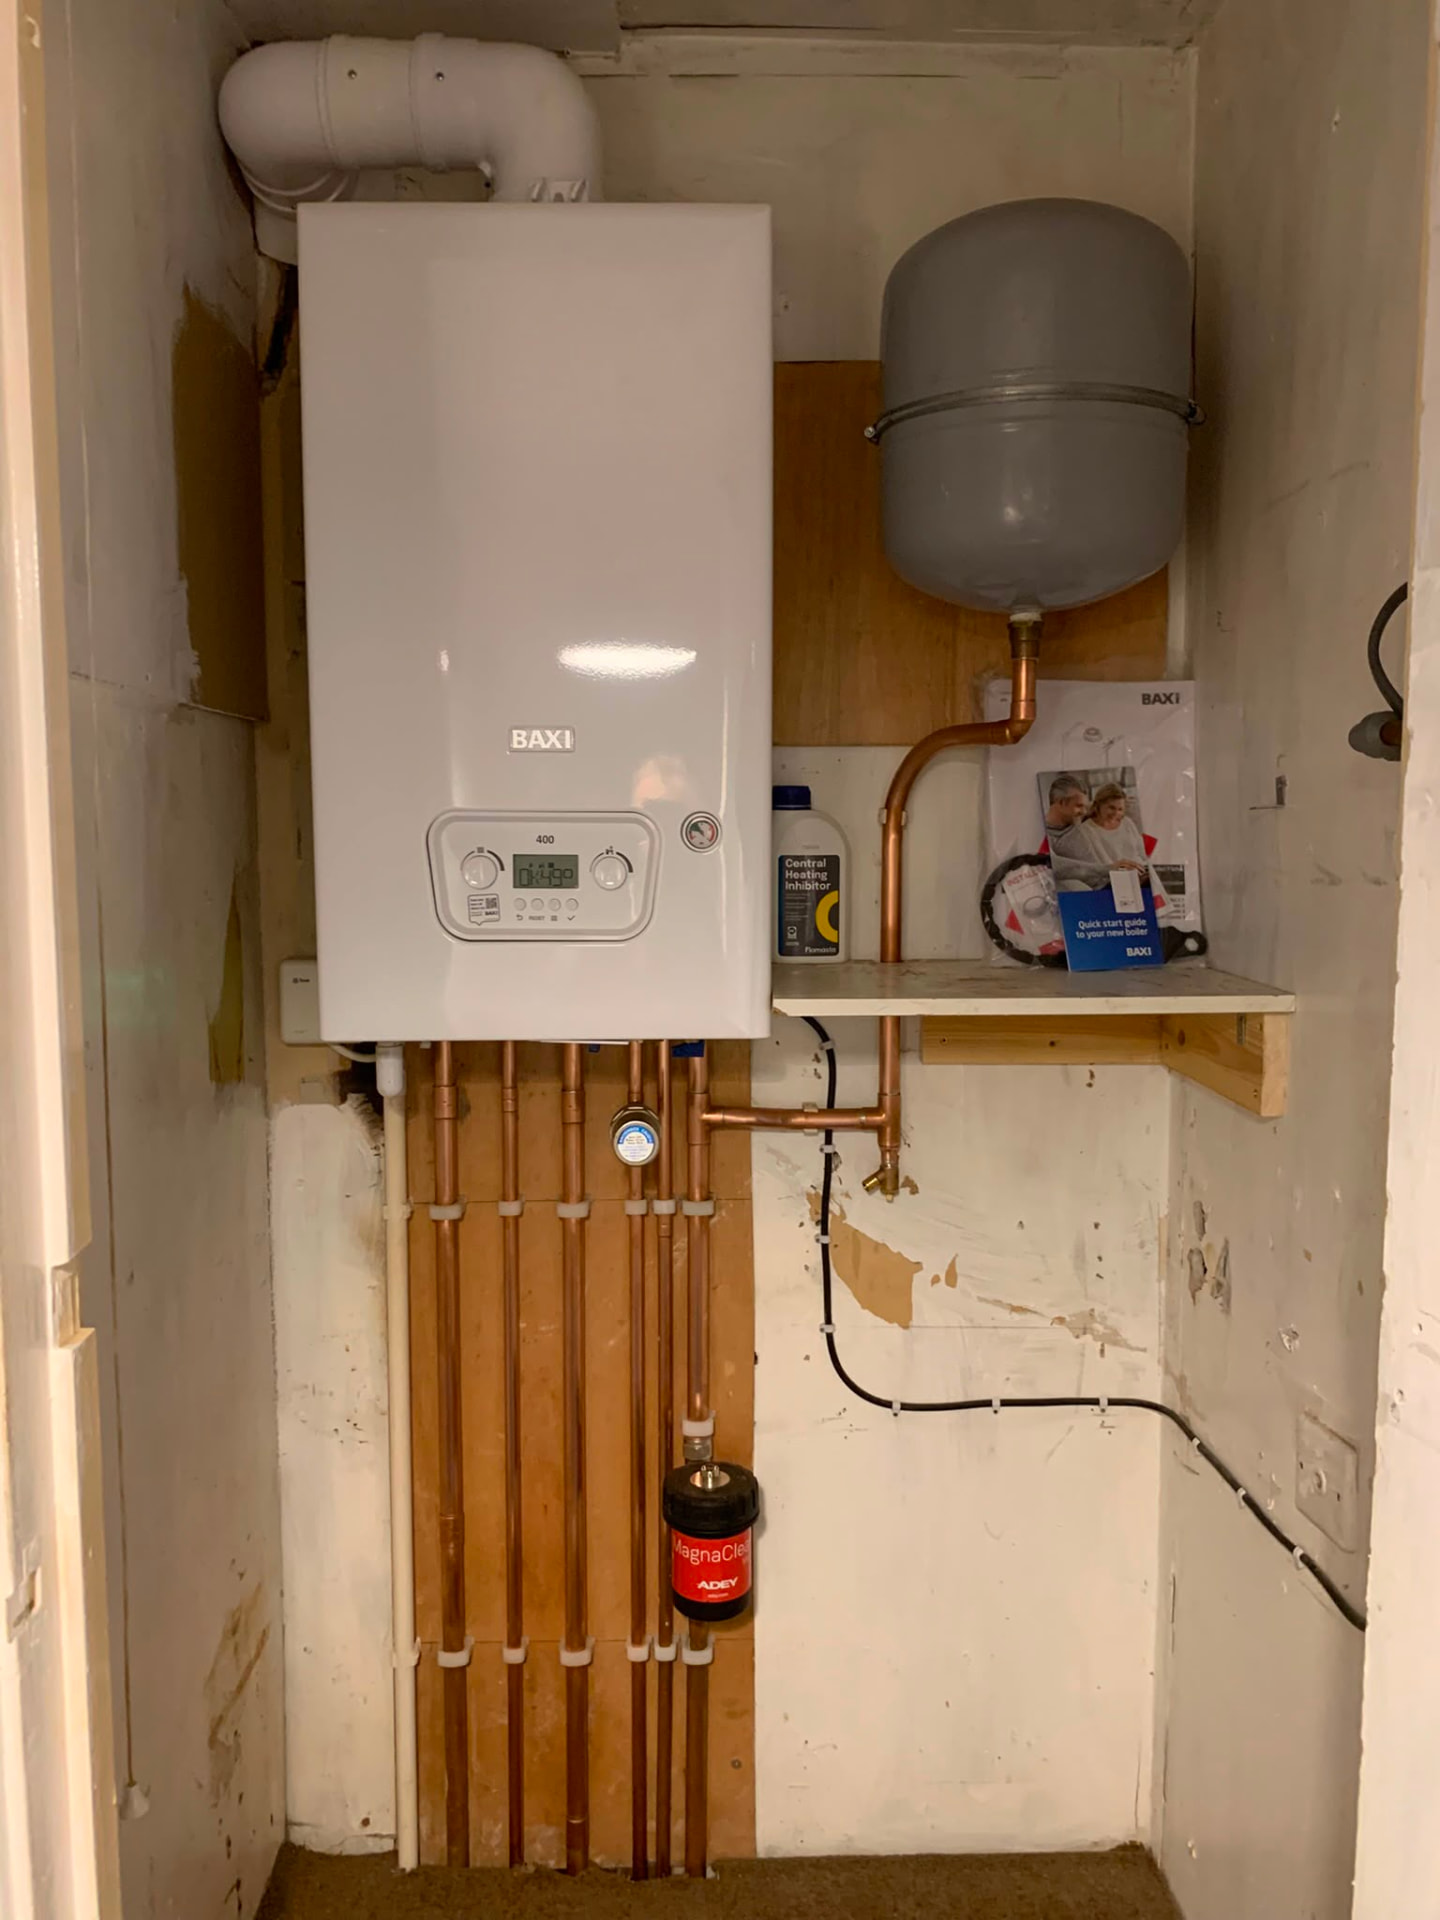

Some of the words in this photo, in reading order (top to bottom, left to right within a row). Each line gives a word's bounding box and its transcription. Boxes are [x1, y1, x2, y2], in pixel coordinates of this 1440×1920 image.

[511, 729, 572, 749] BAXI
[535, 834, 555, 845] 400
[785, 858, 827, 868] Central
[785, 870, 828, 881] Heating
[785, 881, 832, 891] Inhibitor
[1078, 920, 1102, 930] Quick
[1103, 919, 1123, 928] start
[1124, 918, 1147, 928] guide
[1075, 931, 1086, 939] to
[1086, 930, 1105, 940] your
[1106, 929, 1125, 937] new
[1125, 927, 1149, 936] boiler
[697, 1576, 739, 1590] ADEY
